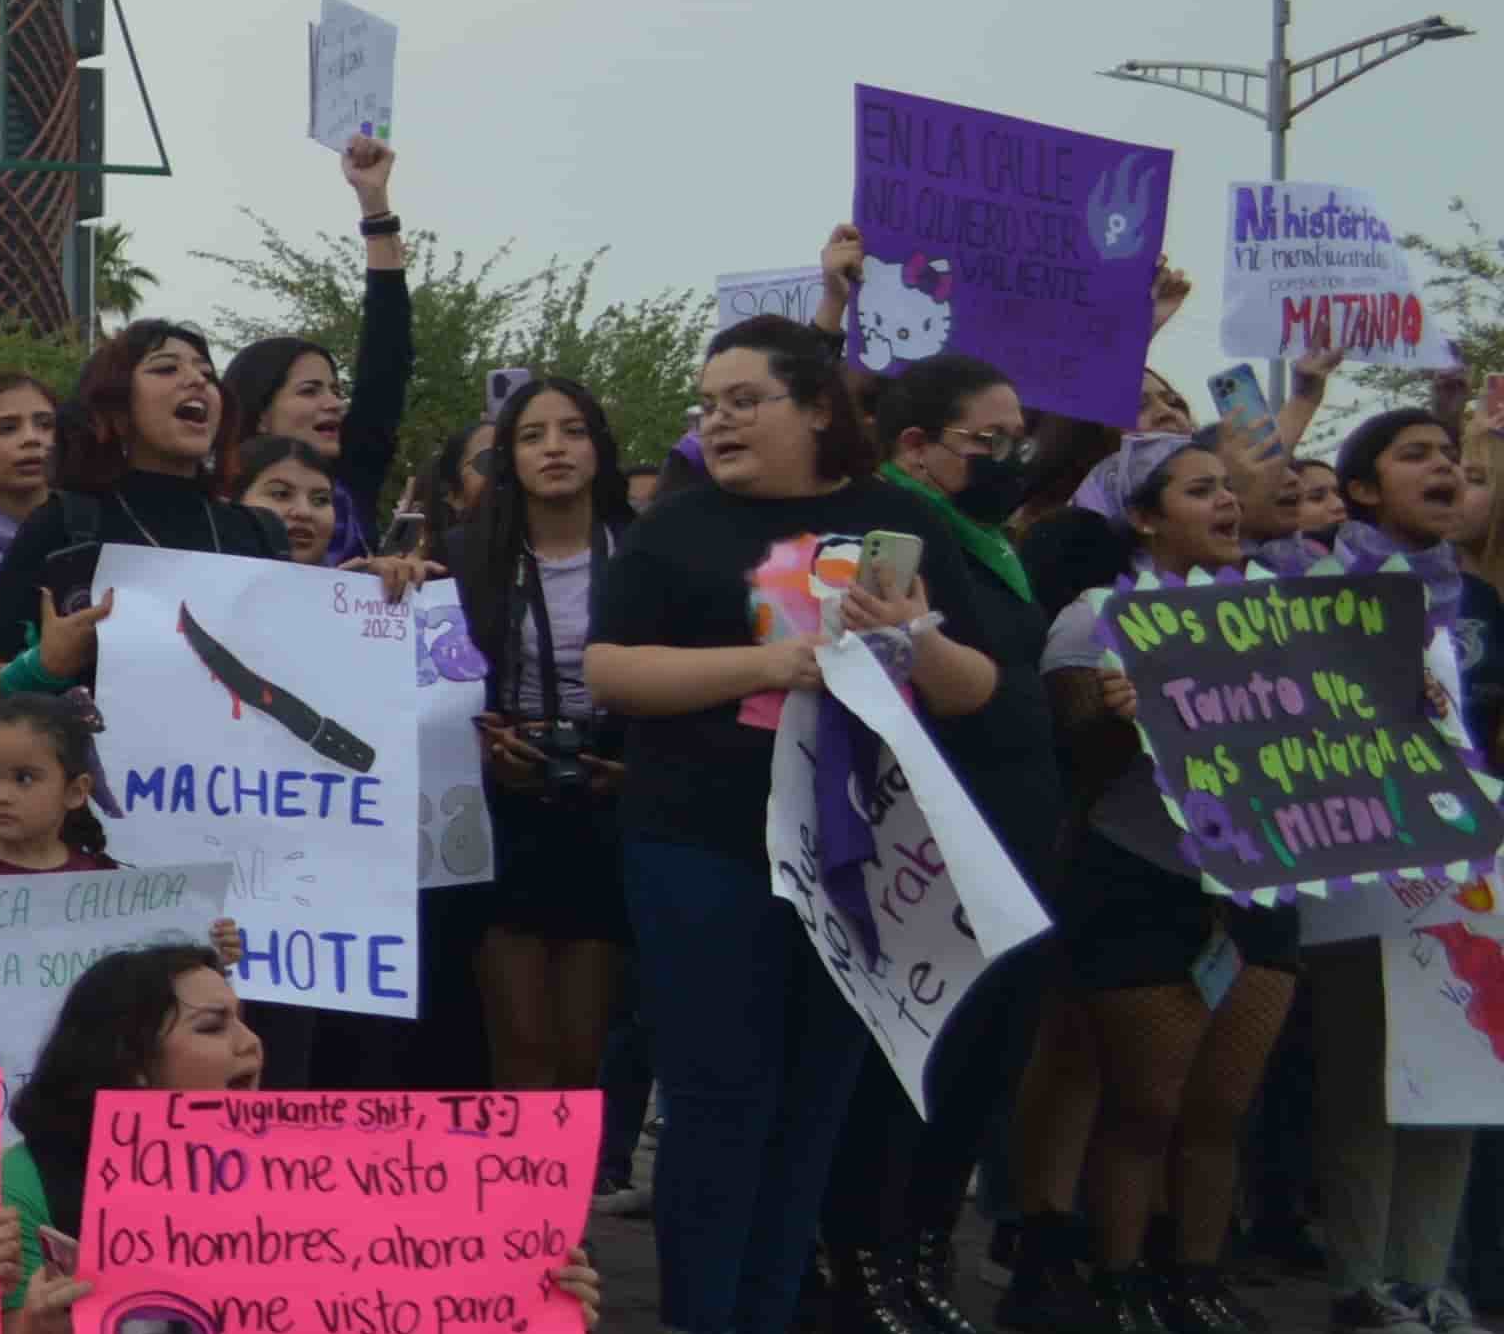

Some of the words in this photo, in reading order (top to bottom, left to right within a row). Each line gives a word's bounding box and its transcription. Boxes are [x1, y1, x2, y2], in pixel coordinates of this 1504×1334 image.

[925, 118, 970, 180] LA
[981, 134, 1074, 206] CALLE
[861, 175, 911, 230] NO
[1023, 200, 1081, 261] SER
[1281, 293, 1425, 357] MATANDO
[361, 618, 407, 640] 2023
[1161, 672, 1305, 732] Tanto
[126, 764, 384, 828] MACHETE
[64, 873, 187, 923] CALLADA
[186, 1142, 246, 1195] no
[262, 1152, 338, 1190] me
[347, 1139, 448, 1195] visto
[477, 1154, 569, 1212] para
[98, 1208, 154, 1273] los
[164, 1214, 362, 1271] hombres,
[368, 1226, 485, 1267] ahora
[504, 1220, 566, 1260] solo
[213, 1296, 293, 1334] me
